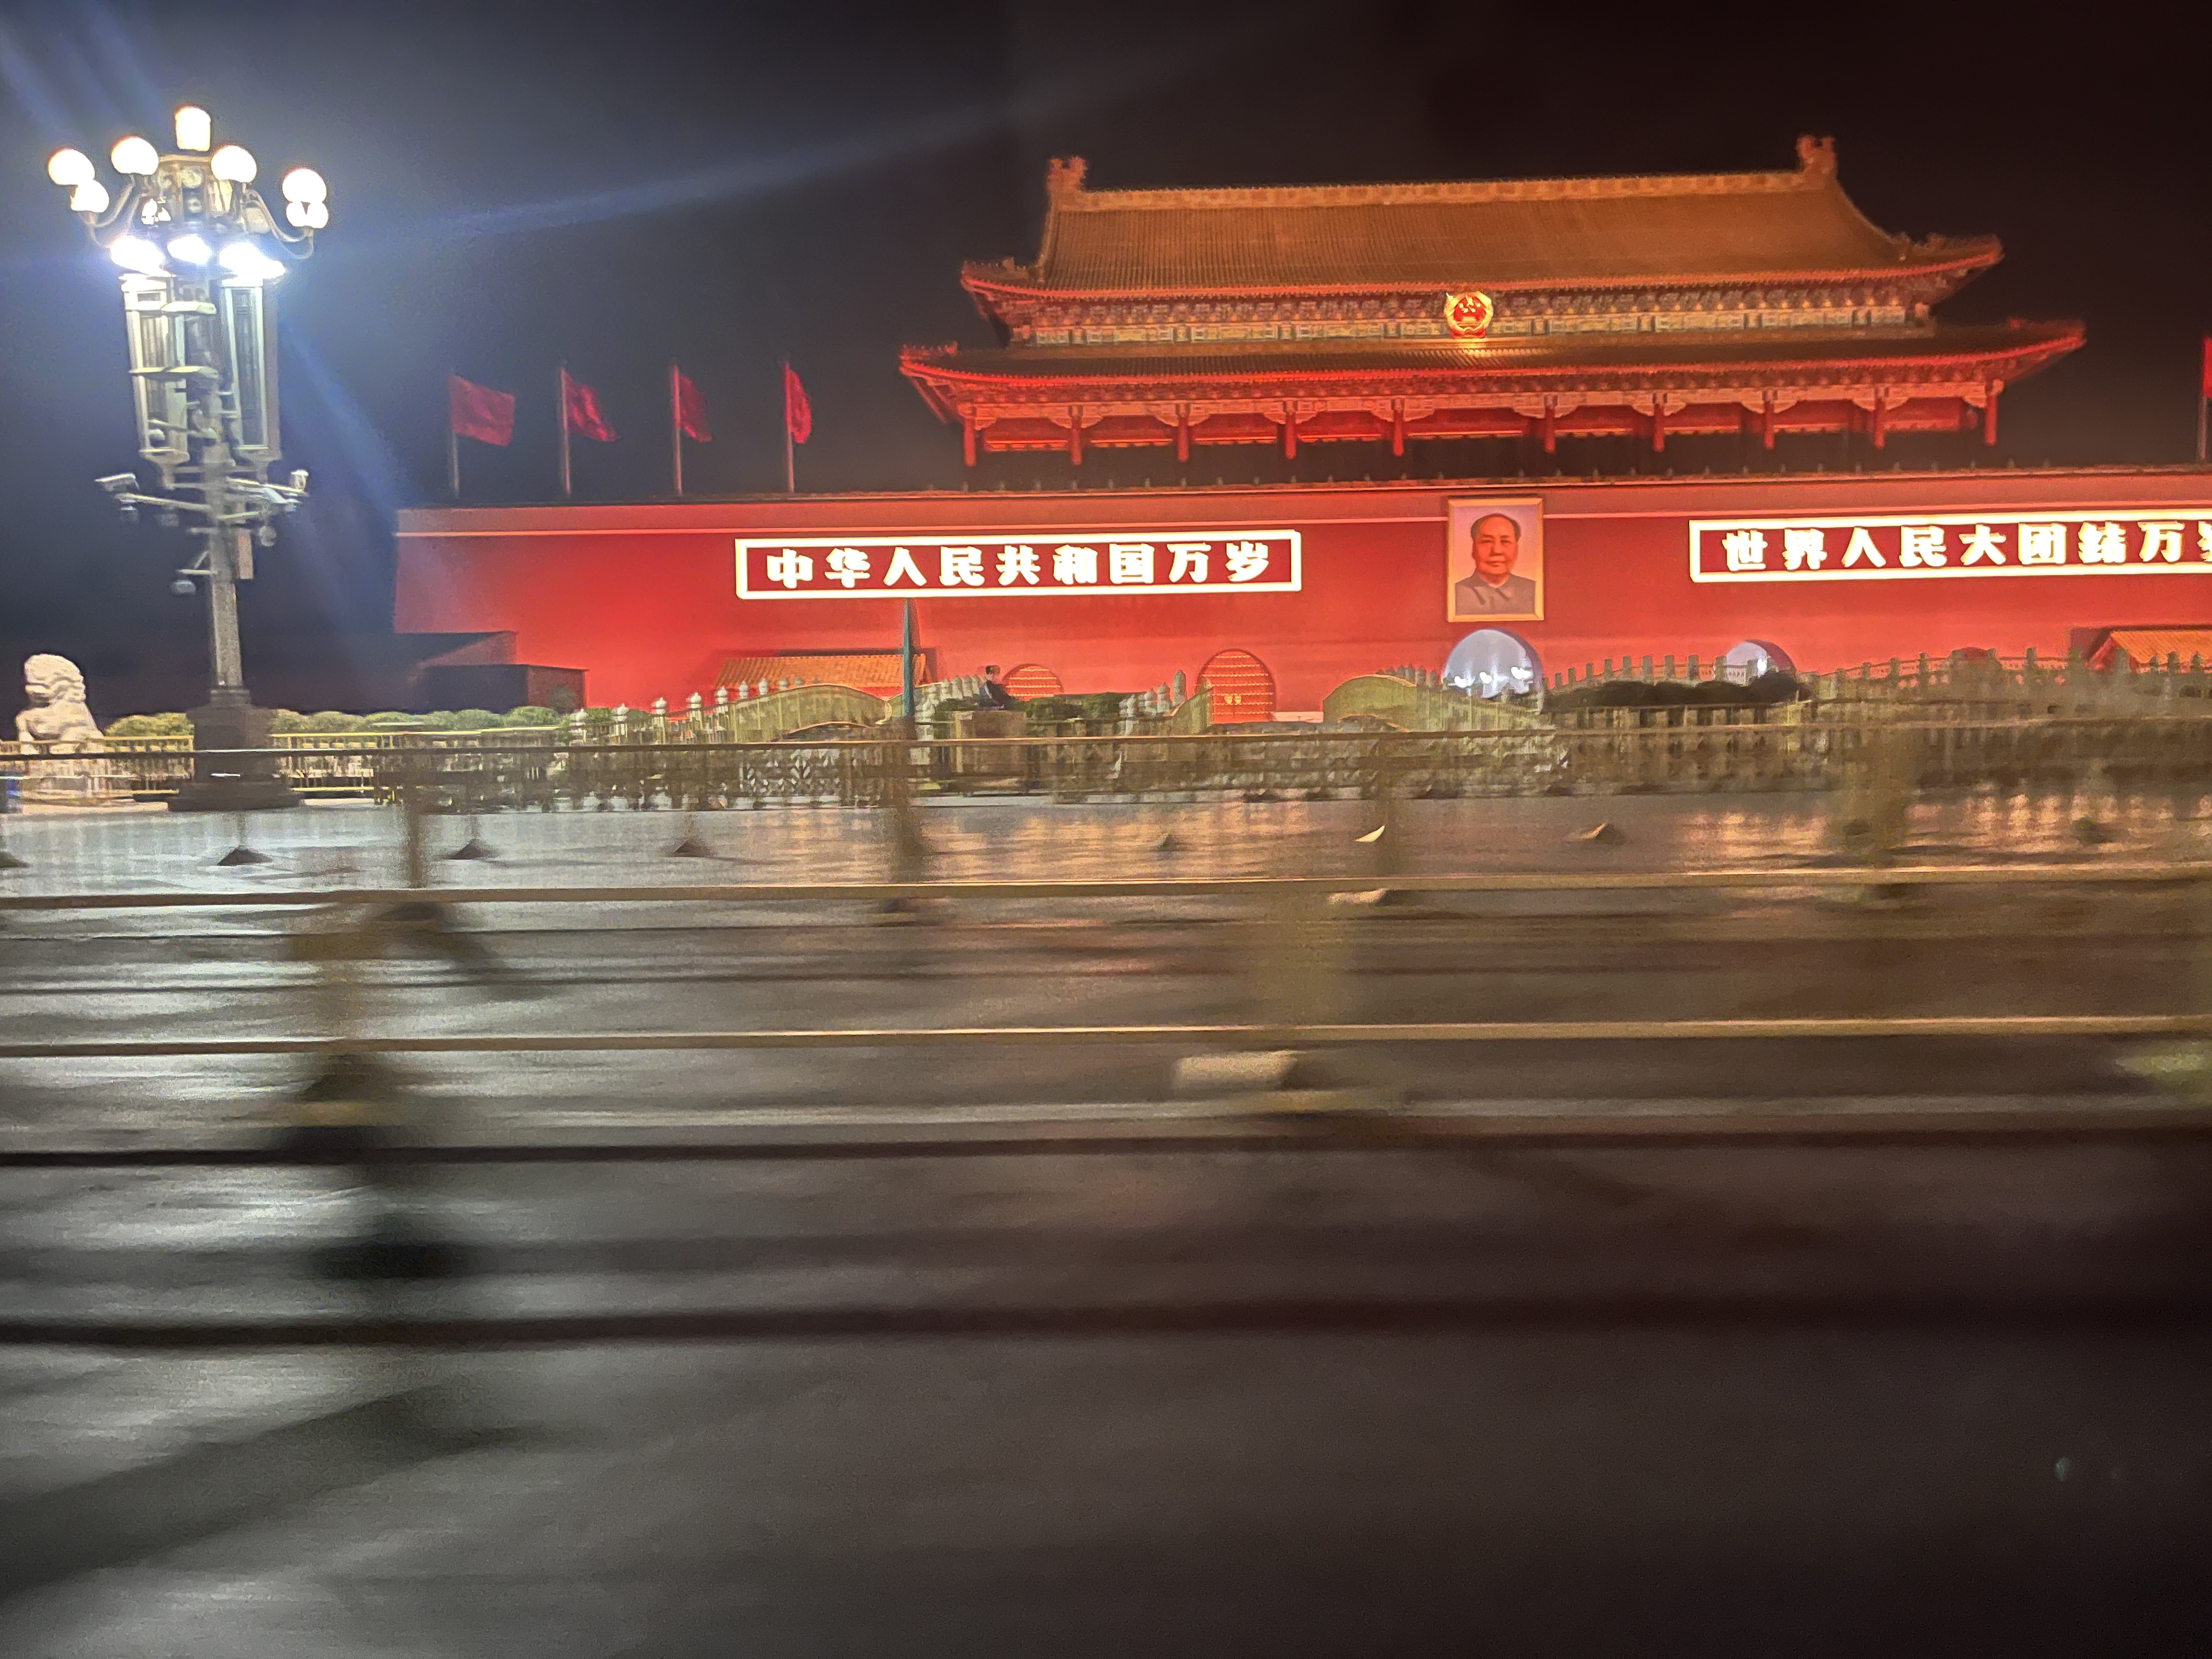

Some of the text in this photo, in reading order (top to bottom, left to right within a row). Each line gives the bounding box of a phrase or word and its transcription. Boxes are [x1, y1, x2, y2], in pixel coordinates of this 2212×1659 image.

[766, 541, 1269, 589] 中华人民共和国万岁
